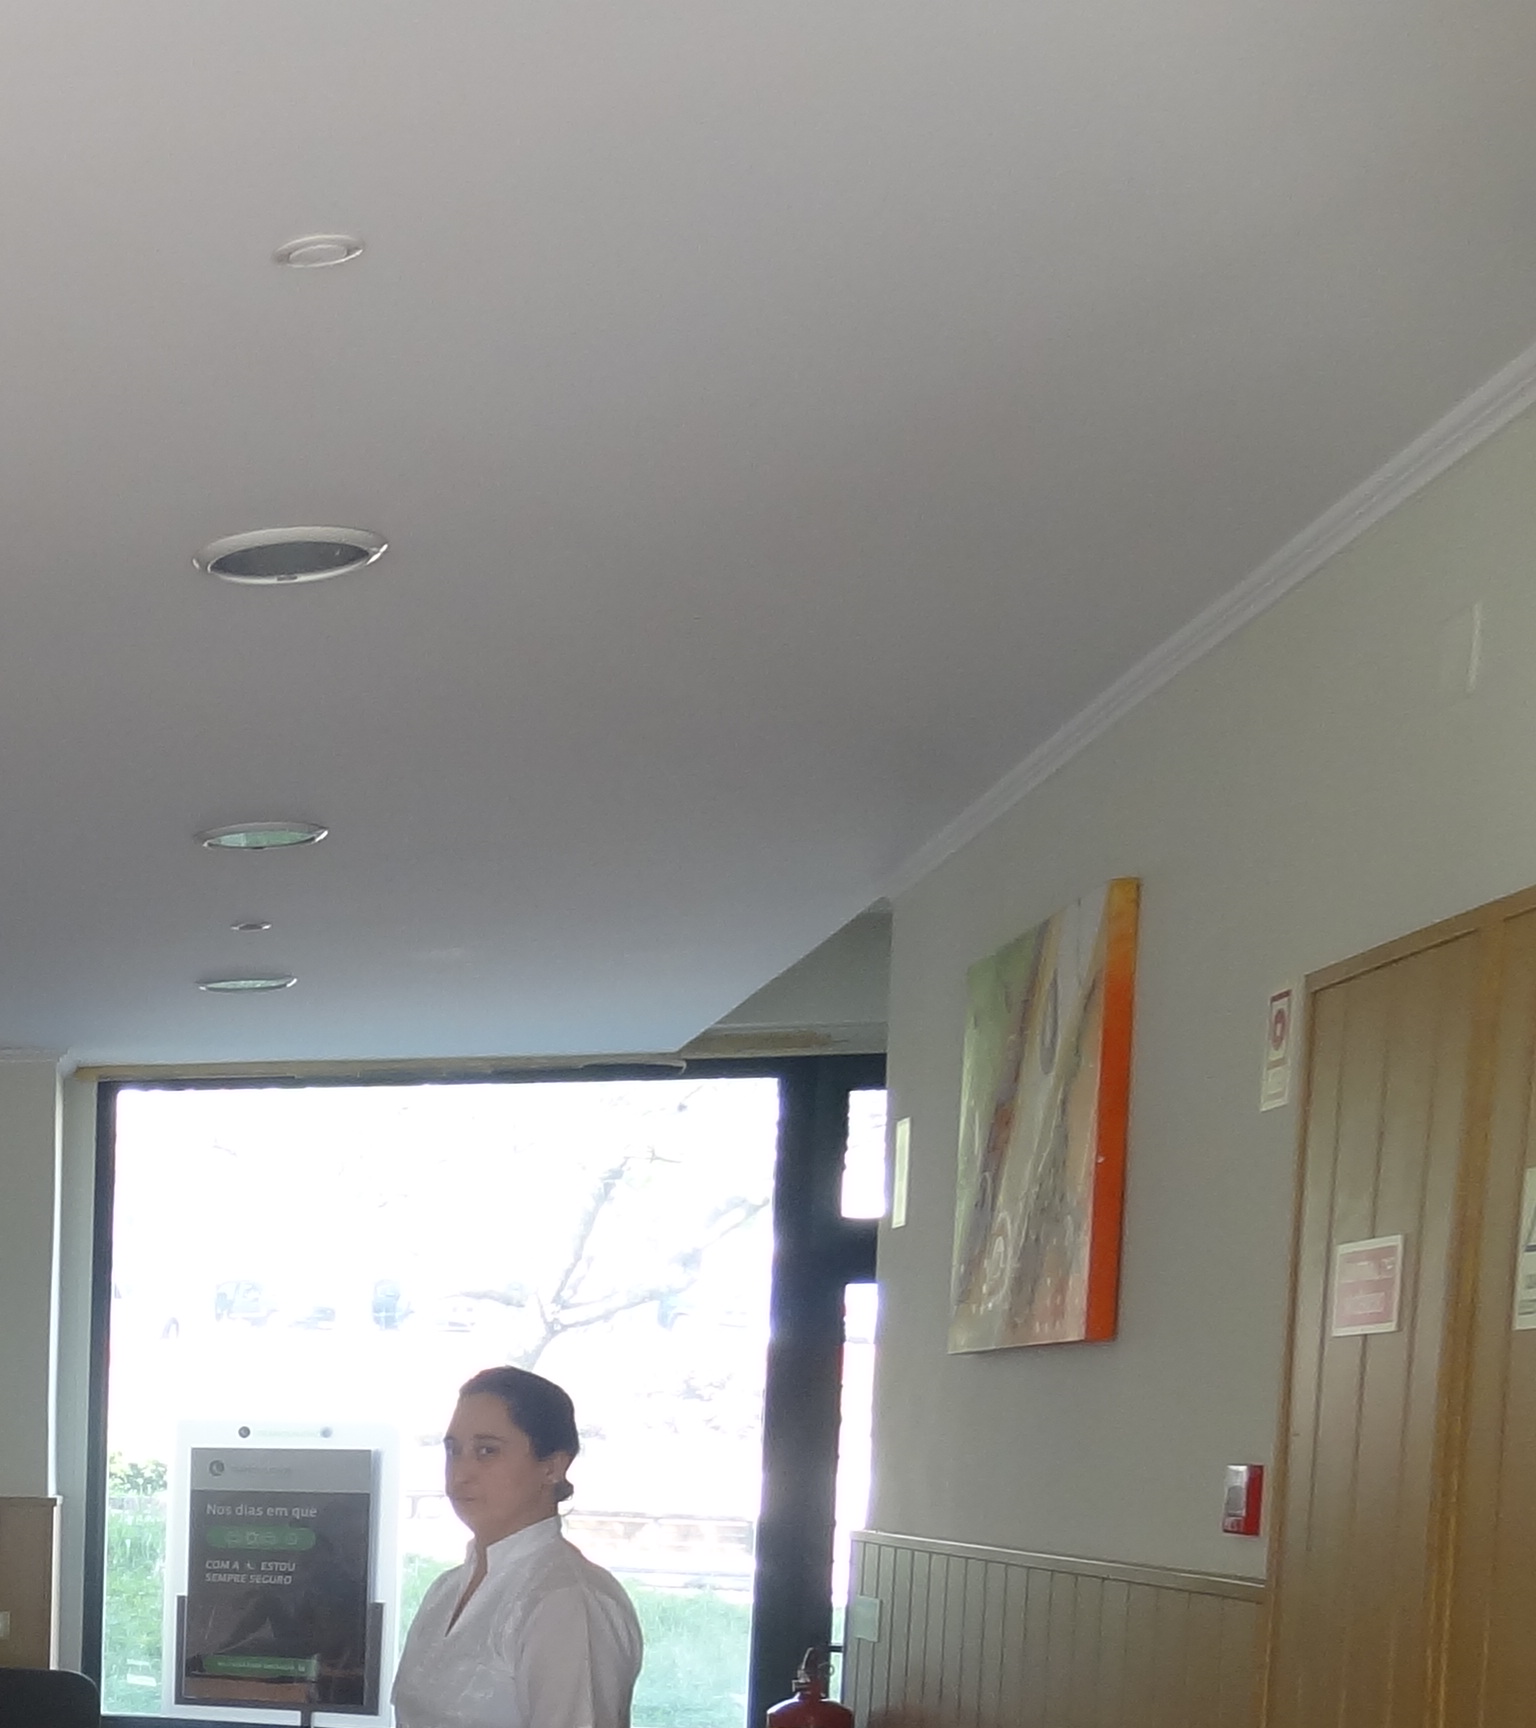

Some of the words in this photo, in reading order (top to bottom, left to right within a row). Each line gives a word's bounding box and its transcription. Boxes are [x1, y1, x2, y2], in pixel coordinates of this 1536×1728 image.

[206, 1503, 232, 1516] Nos
[235, 1504, 264, 1517] dias
[266, 1506, 289, 1517] em
[291, 1507, 318, 1519] que
[205, 1560, 230, 1570] COM
[231, 1560, 240, 1570] A
[260, 1561, 296, 1572] ESTOU
[205, 1572, 247, 1583] SEMPRE
[249, 1573, 293, 1585] SEGURO
